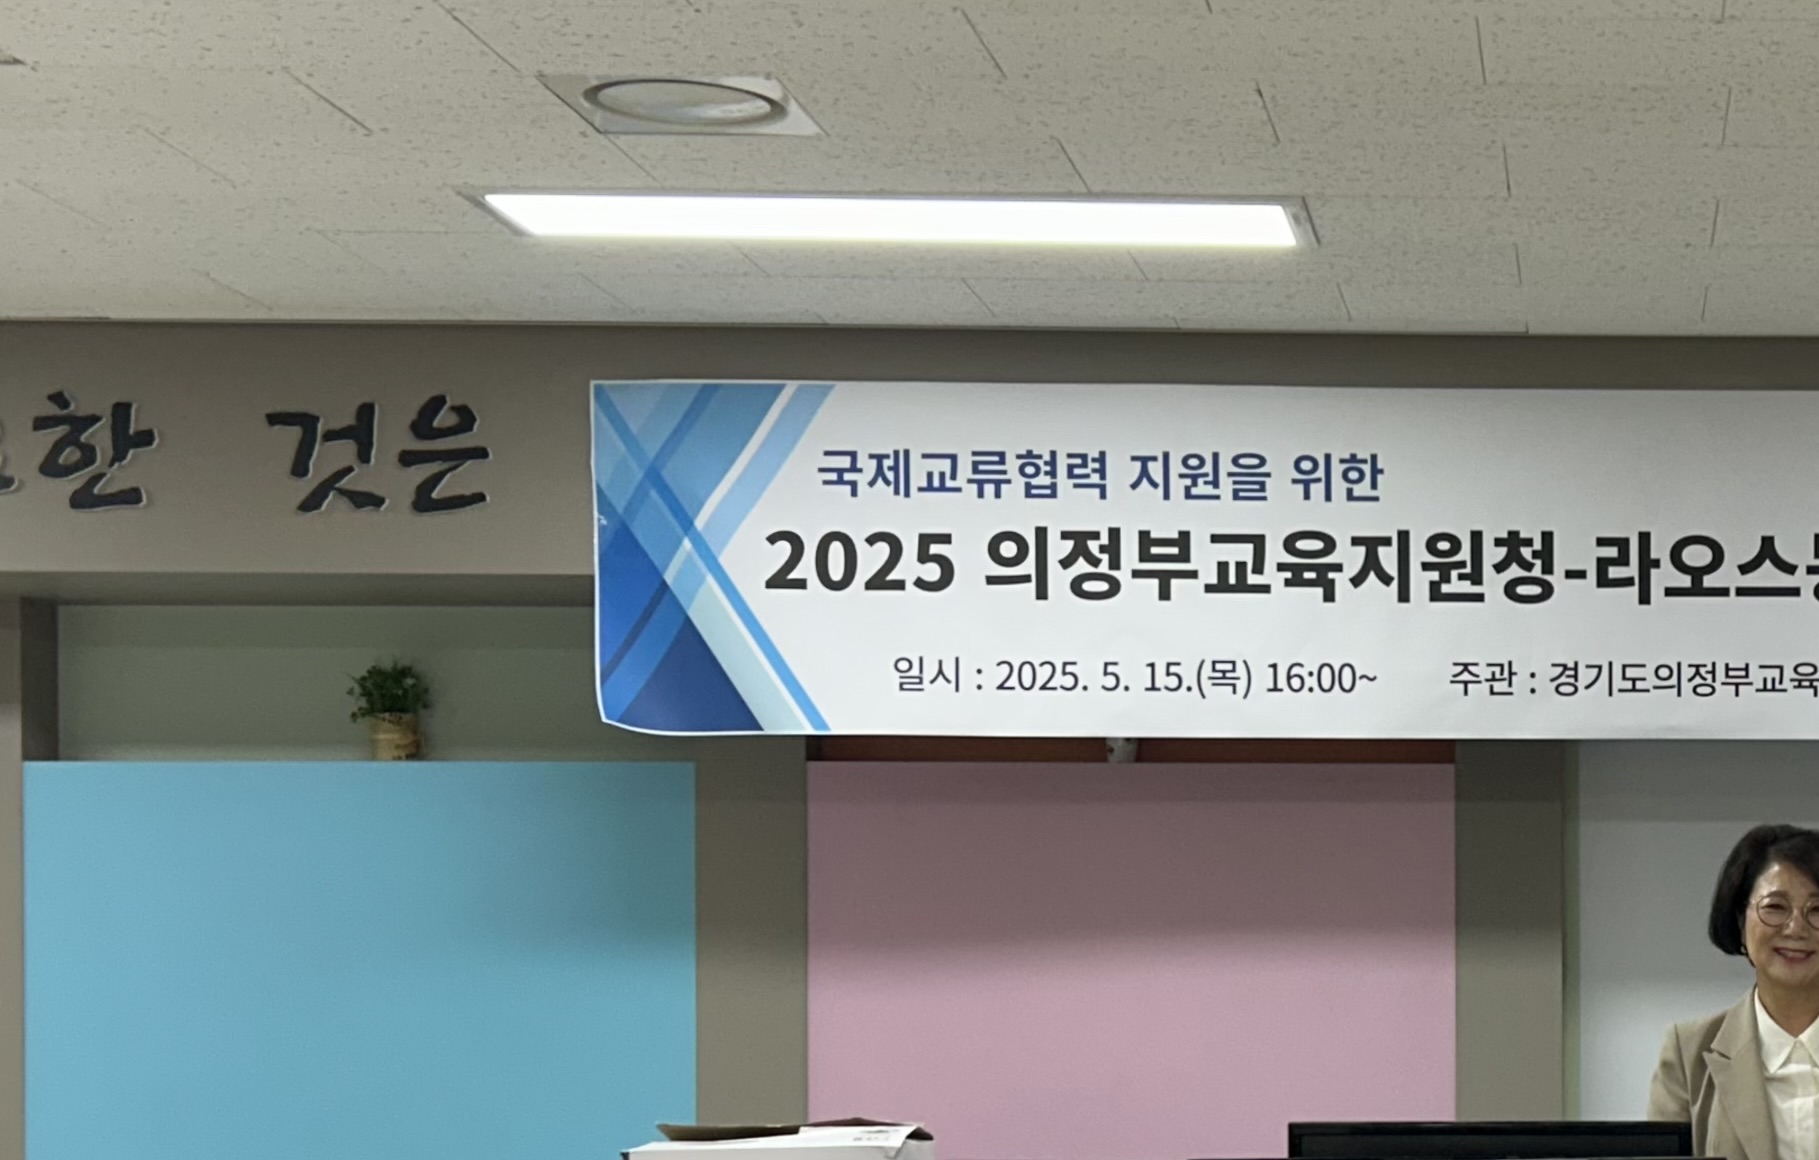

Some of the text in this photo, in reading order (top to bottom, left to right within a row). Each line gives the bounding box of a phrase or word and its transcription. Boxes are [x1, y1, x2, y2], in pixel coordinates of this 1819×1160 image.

[0, 390, 489, 512] 한 것은
[817, 448, 1385, 503] 국제교류협력 지원을 위한
[764, 530, 956, 592] 2025
[893, 656, 962, 694] 일시
[995, 660, 1088, 692] 2025.
[1101, 661, 1130, 692] 5.
[1144, 659, 1252, 700] 15.(목)
[1266, 662, 1378, 694] 16:00~
[1449, 661, 1518, 697] 주관
